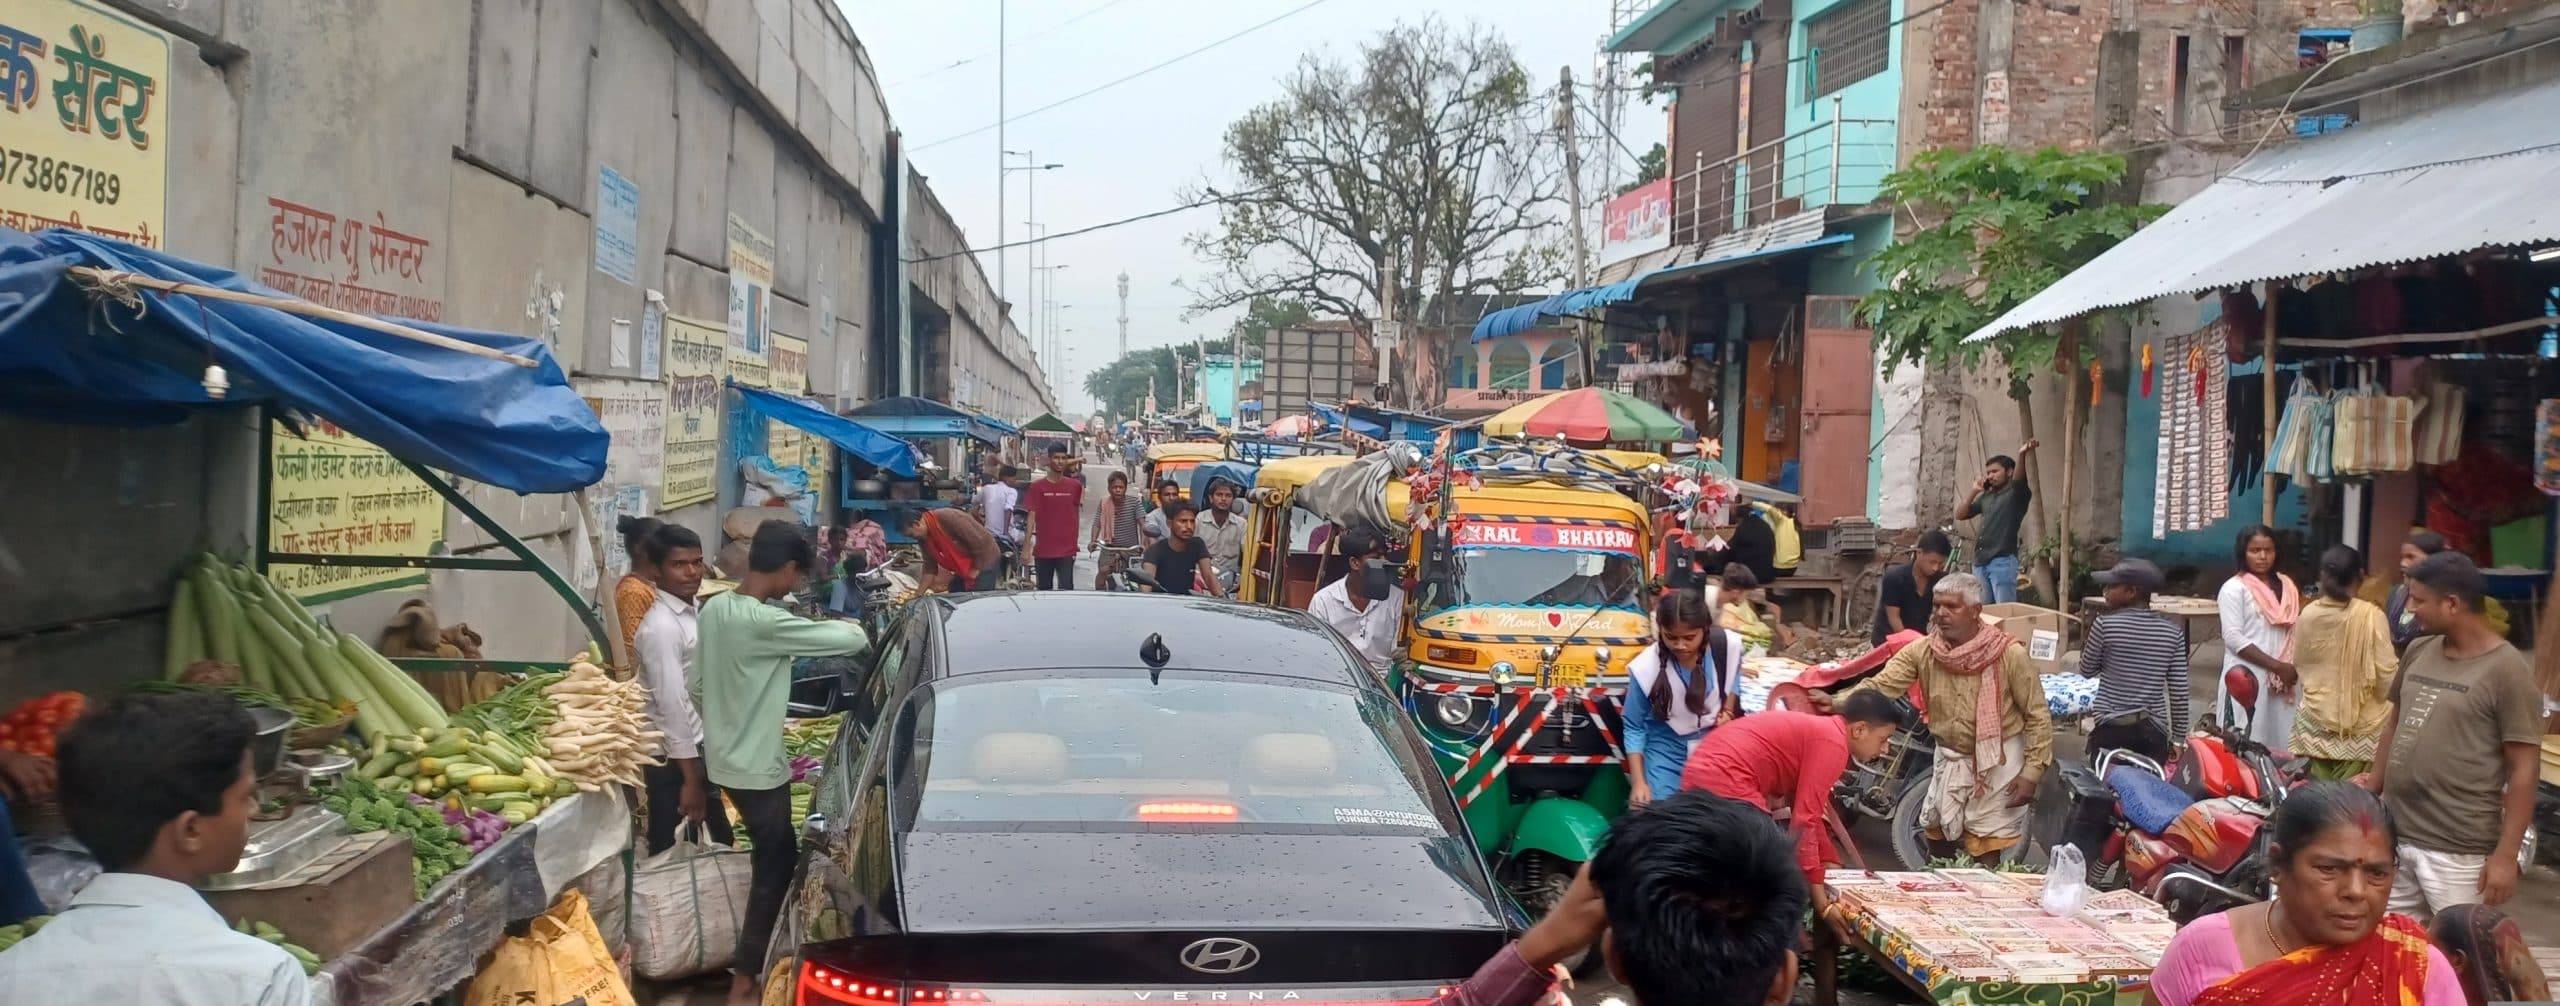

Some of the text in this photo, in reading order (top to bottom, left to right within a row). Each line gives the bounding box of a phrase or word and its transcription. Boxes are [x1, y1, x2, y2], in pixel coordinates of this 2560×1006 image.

[52, 24, 155, 151] सेंटर
[268, 196, 429, 284] हजरत शु सेन्टर
[1557, 528, 1634, 548] BHAIRAV
[1334, 808, 1372, 817] ASMA
[1134, 989, 1300, 1001] VERNA
